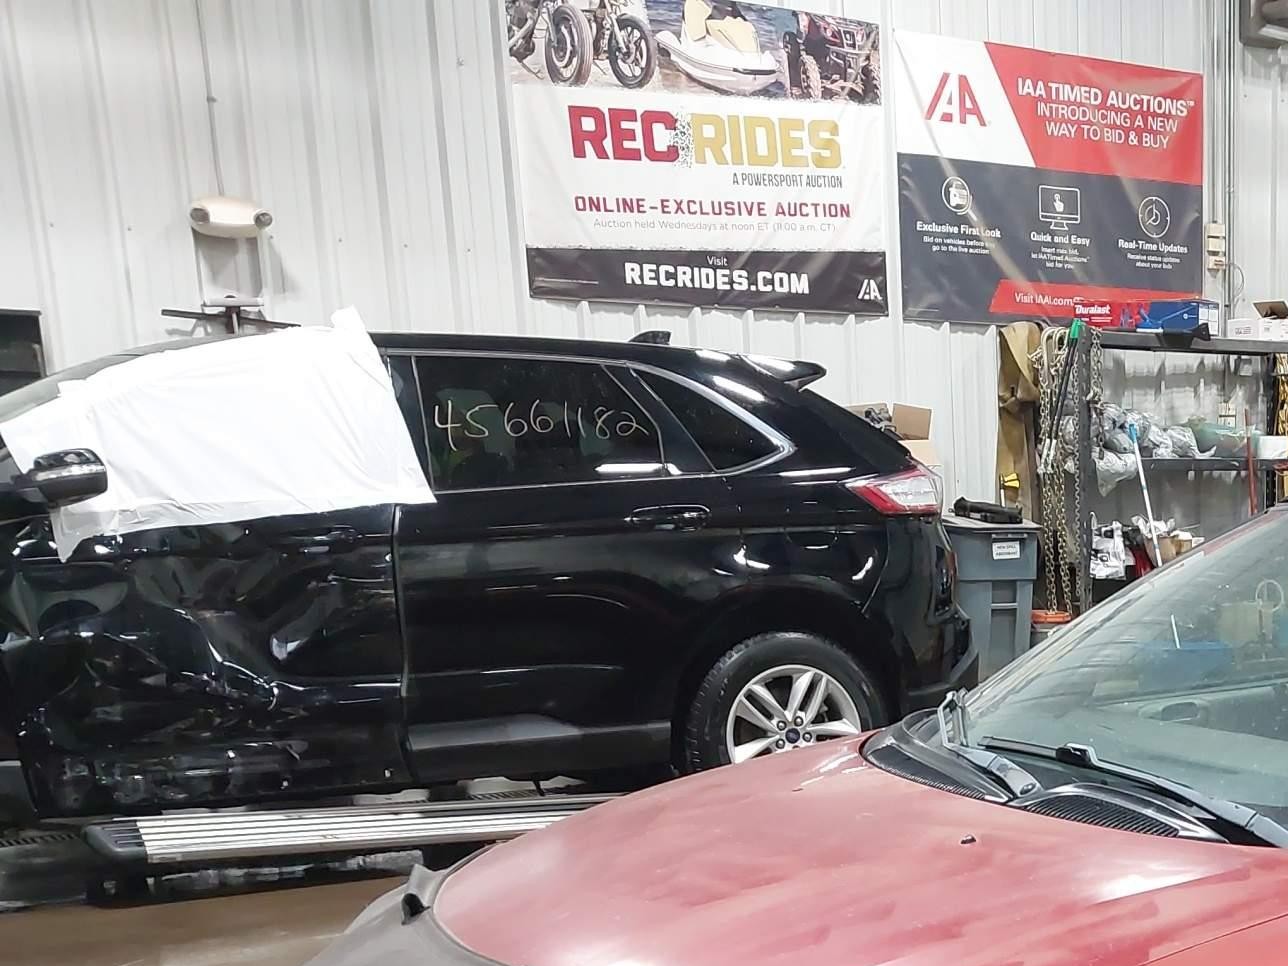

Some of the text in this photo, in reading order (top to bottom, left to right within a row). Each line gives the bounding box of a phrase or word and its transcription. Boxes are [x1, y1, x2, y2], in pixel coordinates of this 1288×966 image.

[1017, 77, 1046, 98] IAA
[1048, 82, 1102, 106] TIMED
[1037, 101, 1178, 133] INTRODUCING A NEW
[690, 113, 843, 169] RIDES
[1046, 121, 1169, 149] WAY TO BID & BUY
[732, 172, 843, 189] A POWERSPORT AUCTION
[574, 196, 852, 218] ONLINE-EXCLUSIVE AUCTION
[593, 218, 632, 229] Auction
[634, 219, 656, 230] held
[658, 219, 718, 231] Wednesdays
[719, 222, 729, 231] at
[731, 222, 755, 231] noon
[757, 222, 769, 231] ET
[916, 220, 959, 234] Exclusive
[960, 224, 980, 236] First
[1030, 231, 1091, 248] Quick and Easy
[1118, 238, 1188, 254] Real-Time Updates
[707, 256, 728, 266] Visit
[624, 261, 810, 295] RECRIDES.COM
[1014, 293, 1034, 304] Visit
[1075, 304, 1111, 315] Duralast
[434, 400, 649, 451] 45661182
